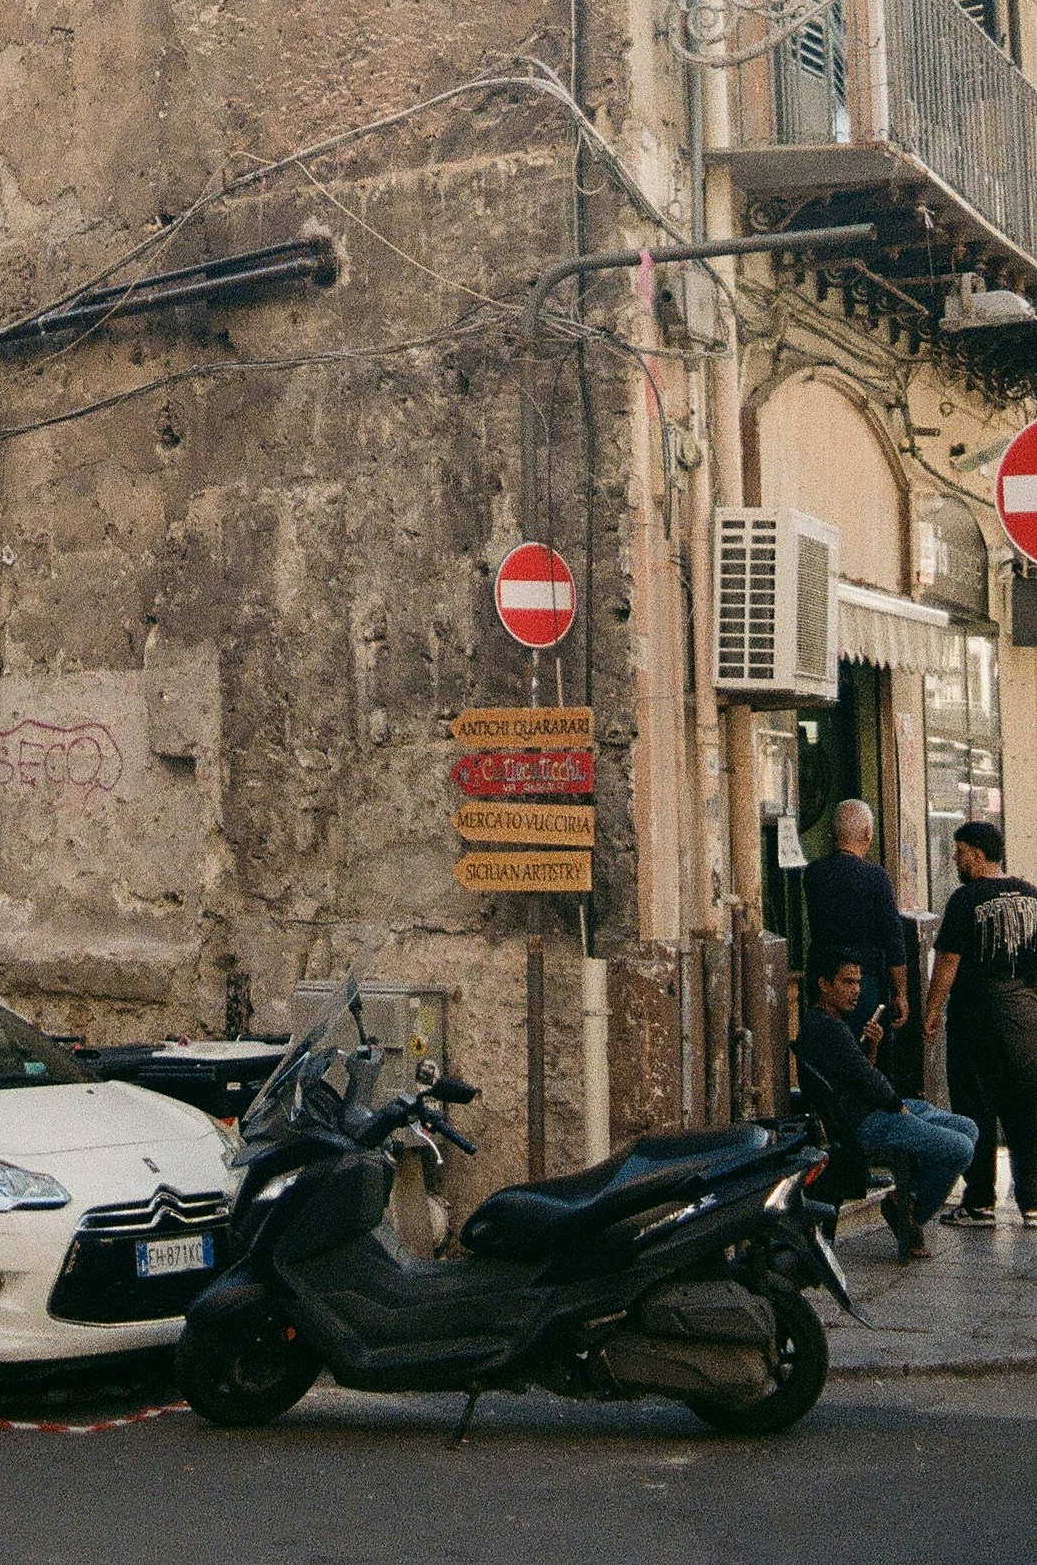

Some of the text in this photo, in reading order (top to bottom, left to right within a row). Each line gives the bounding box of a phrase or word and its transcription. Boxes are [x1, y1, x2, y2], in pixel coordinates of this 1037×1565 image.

[458, 720, 509, 736] ANTICHI
[457, 811, 523, 830] MERCATO
[465, 863, 582, 881] SICILIAN ARTISTRY
